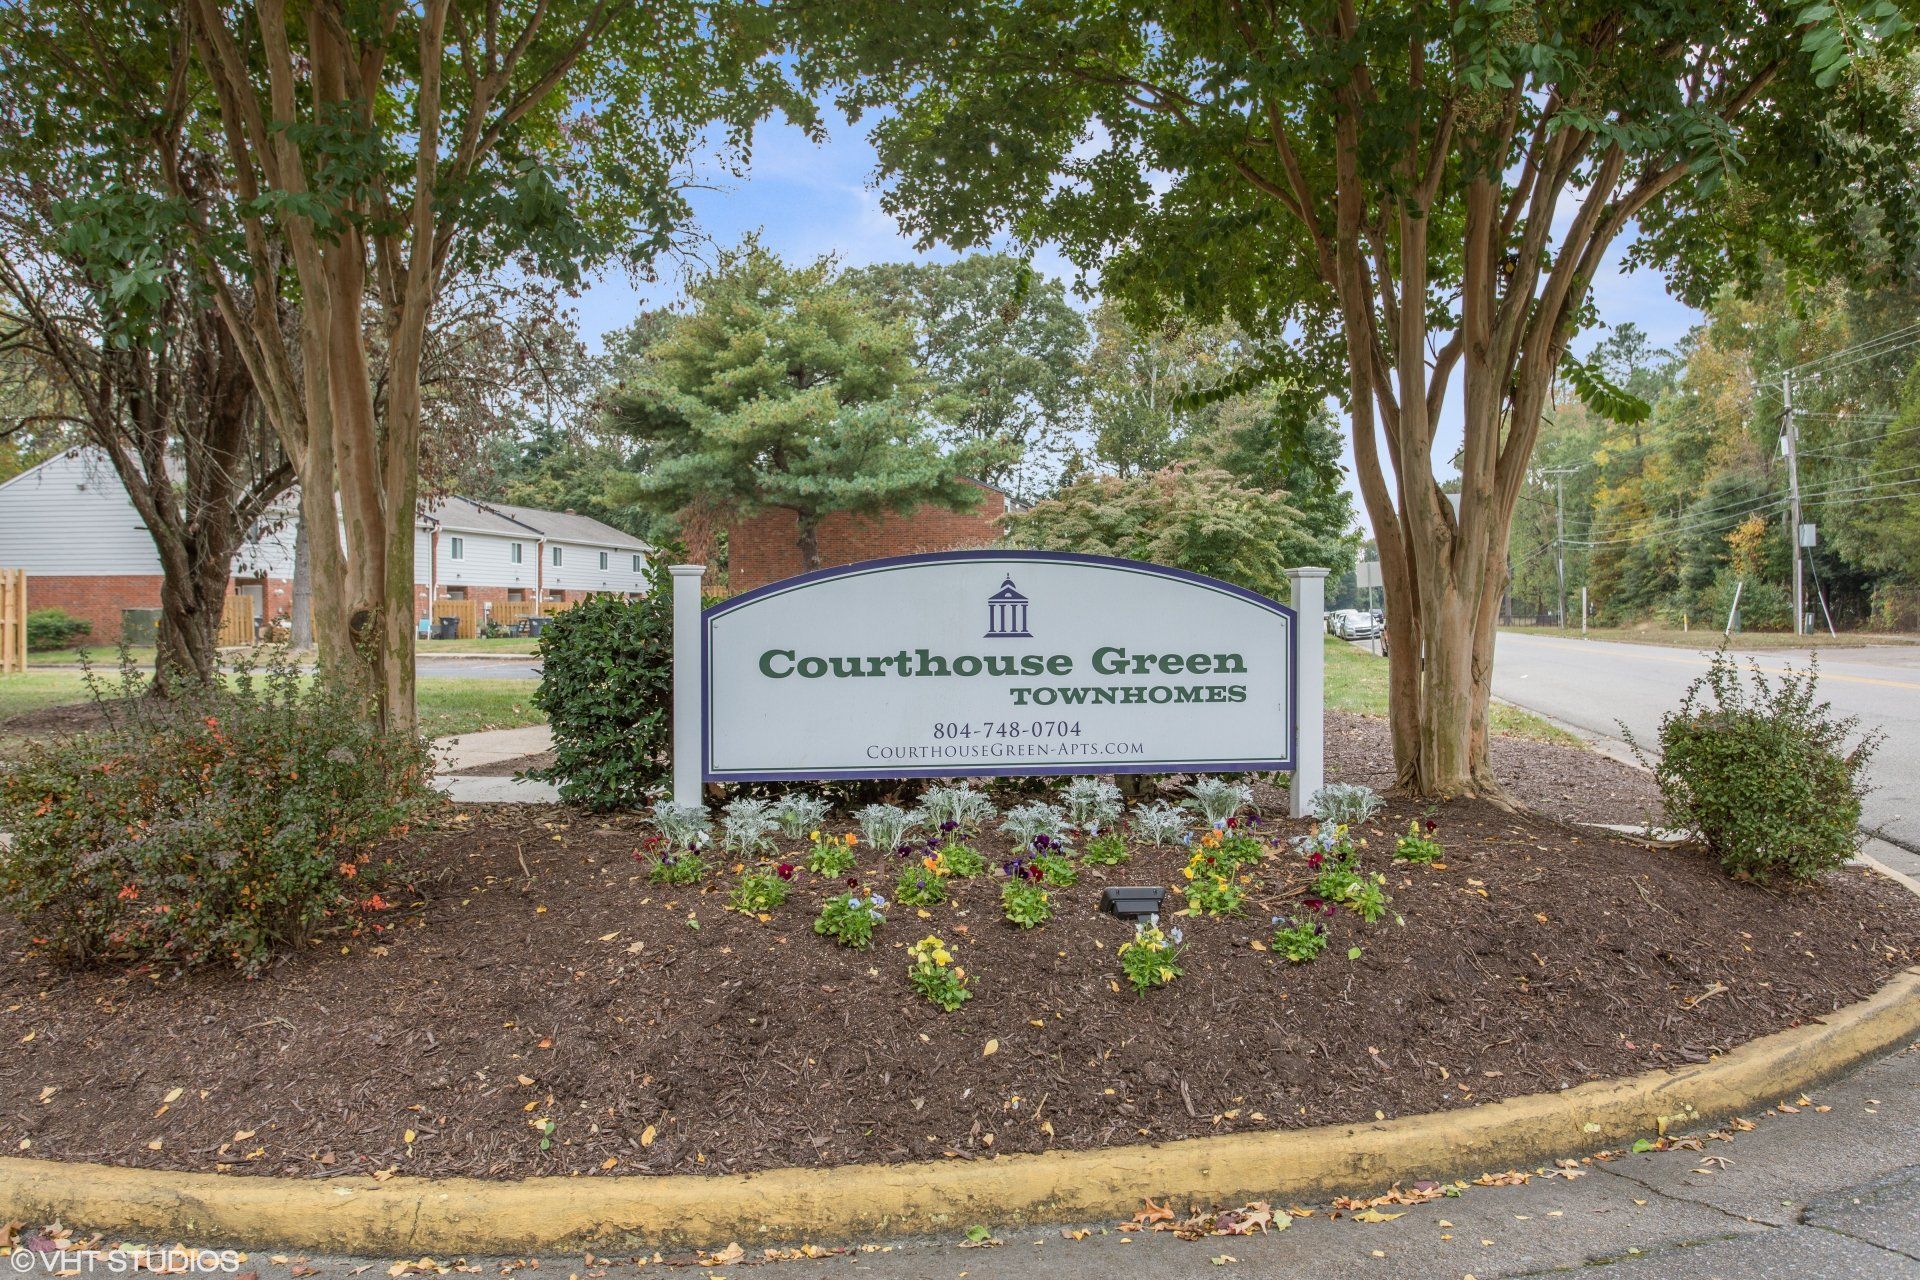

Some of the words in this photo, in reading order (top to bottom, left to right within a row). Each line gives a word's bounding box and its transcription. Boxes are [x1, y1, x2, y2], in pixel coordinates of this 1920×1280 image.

[759, 648, 1073, 678] Courthouse
[1091, 647, 1248, 676] Green
[1010, 685, 1247, 705] TOWNHOMES
[933, 720, 1082, 739] 804-748-0704
